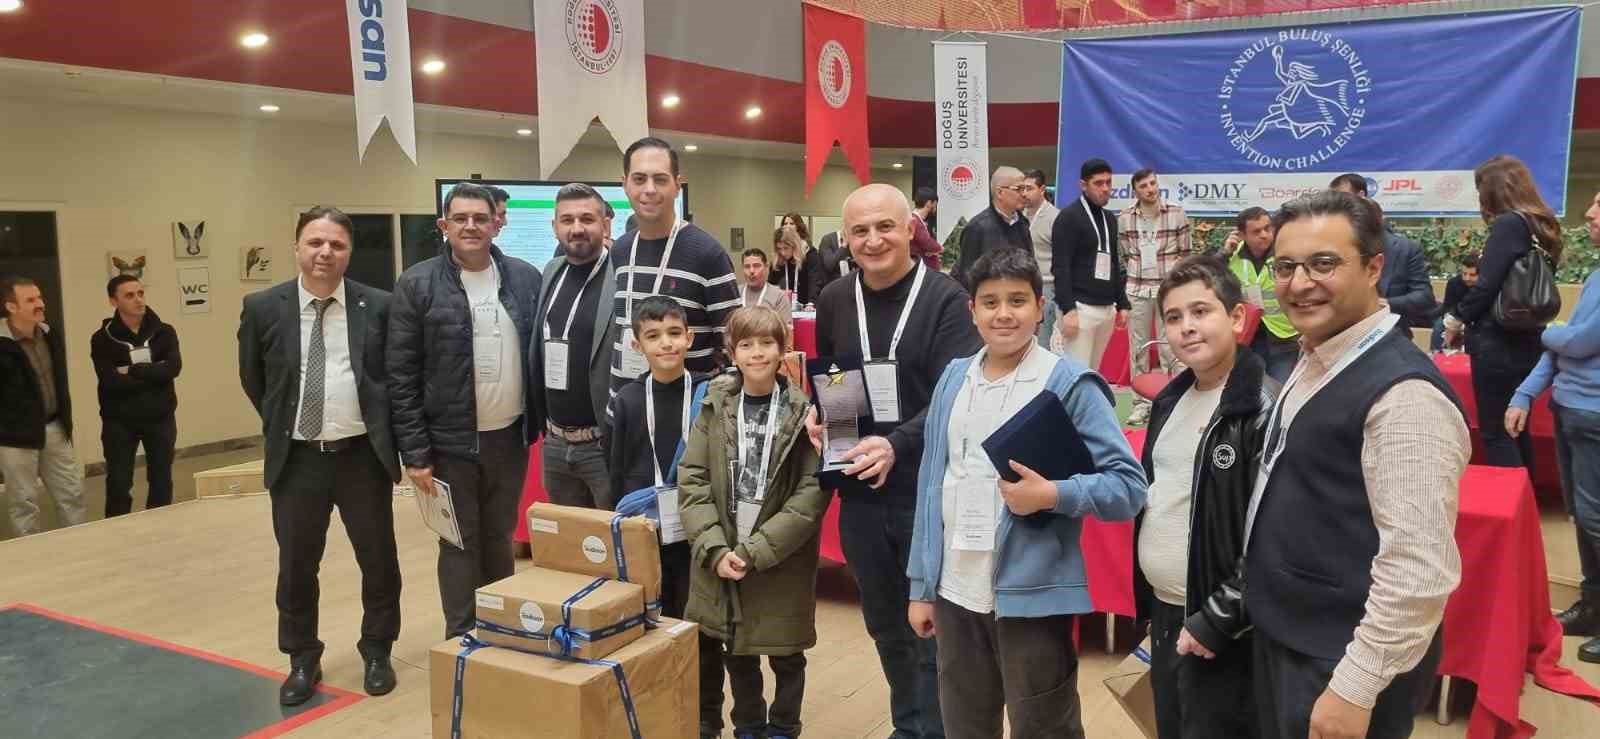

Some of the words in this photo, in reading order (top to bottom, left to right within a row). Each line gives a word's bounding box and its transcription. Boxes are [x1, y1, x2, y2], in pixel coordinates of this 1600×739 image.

[1218, 36, 1275, 99] İSTANBUL
[1278, 28, 1331, 47] BULUŞ
[1331, 38, 1372, 94] ŞENLİĞİ
[942, 100, 954, 149] DOĞUŞ
[1220, 112, 1281, 169] INVENTION
[1285, 107, 1366, 170] CHALLENGE
[1194, 183, 1247, 199] DMY
[1383, 179, 1423, 191] JPL
[182, 284, 209, 295] WC
